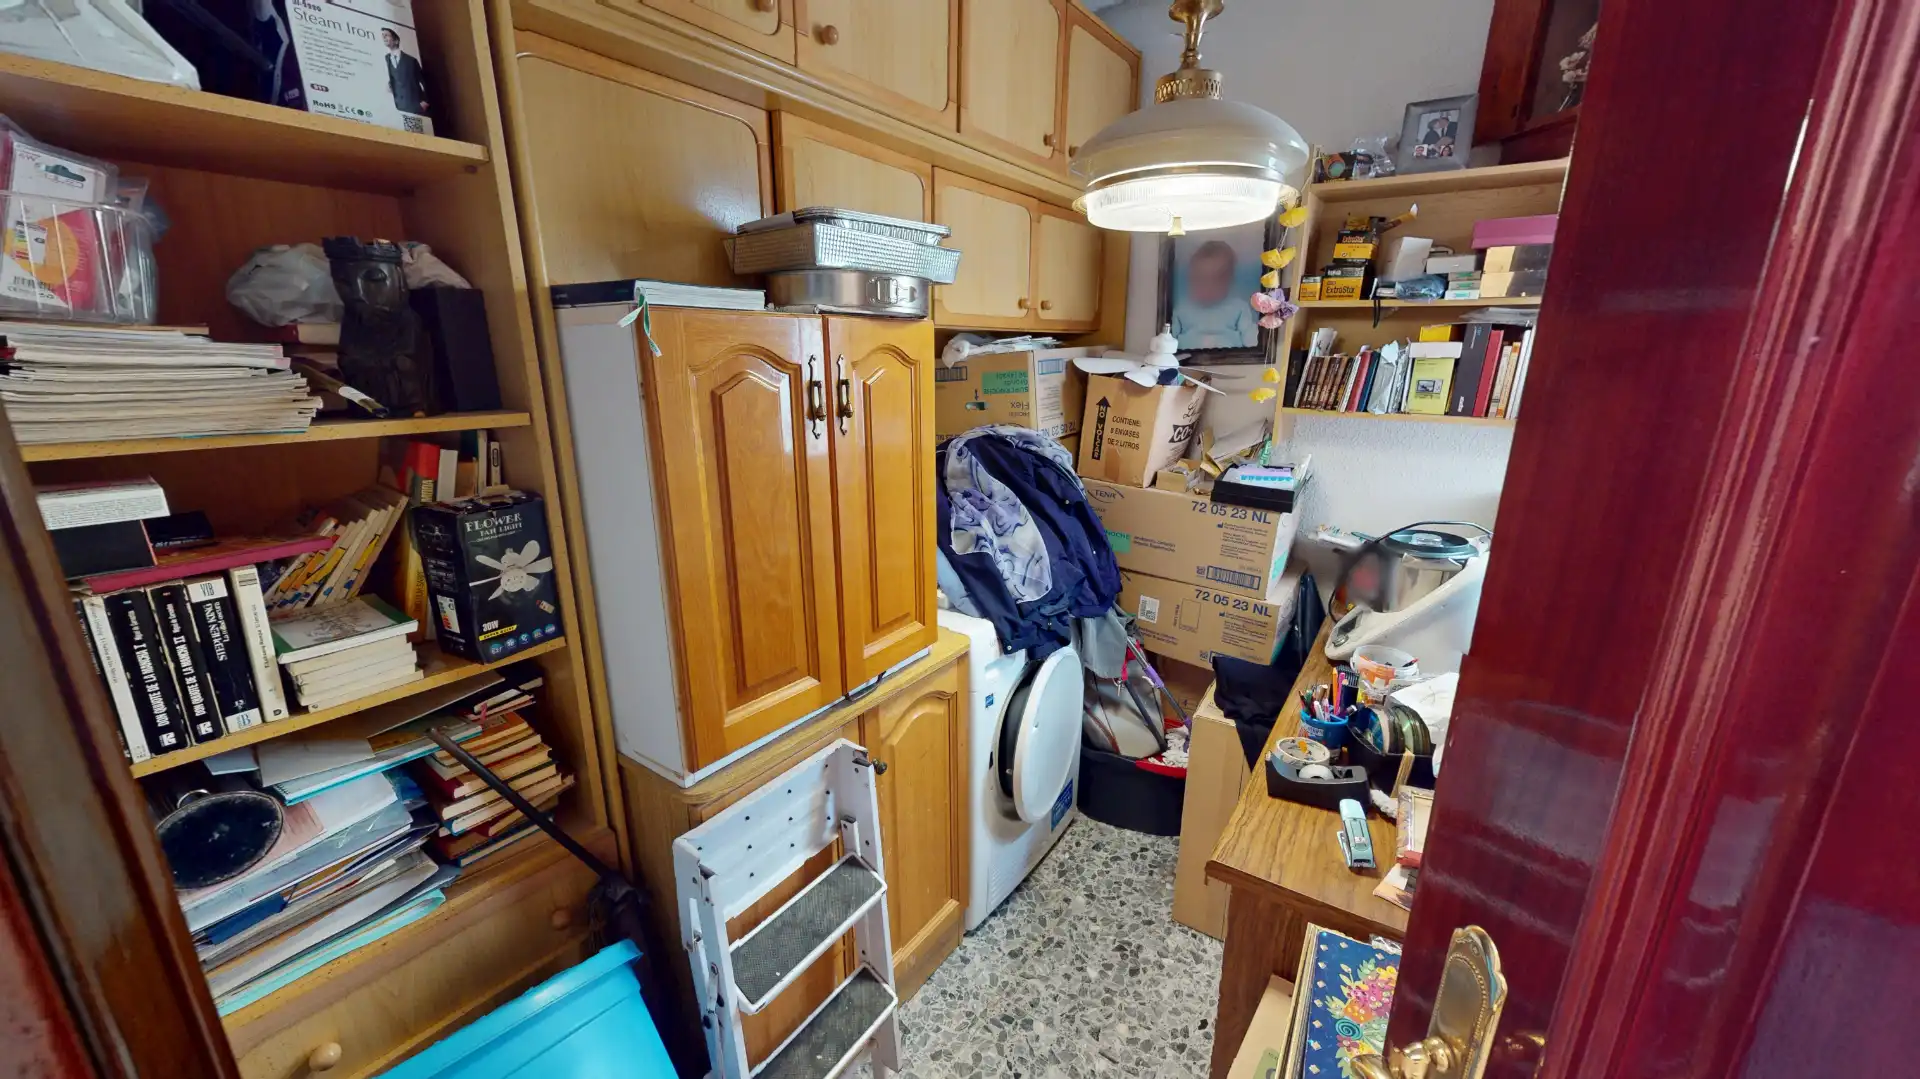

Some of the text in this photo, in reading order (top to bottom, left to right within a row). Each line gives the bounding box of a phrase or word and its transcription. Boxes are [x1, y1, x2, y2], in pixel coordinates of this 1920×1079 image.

[293, 7, 376, 41] Steam Iron
[312, 99, 336, 110] RoHS
[1094, 405, 1106, 459] NO VOLCAR
[1115, 428, 1140, 439] ENVASES
[1107, 437, 1115, 446] DE
[1119, 441, 1140, 450] LITROS
[465, 512, 523, 533] FLOWER
[1191, 500, 1272, 525] 72 05 23 NL
[200, 582, 215, 597] VIB
[1194, 589, 1273, 618] 72 05 23 NL
[202, 603, 228, 662] STEPHEN KING
[135, 650, 155, 676] MANCHA
[142, 672, 157, 683] LA
[172, 634, 207, 717] DON QUIJOTE DE LA MANCHA II
[145, 682, 160, 692] DE
[148, 691, 168, 715] QUIJOTE
[155, 713, 170, 727] DON
